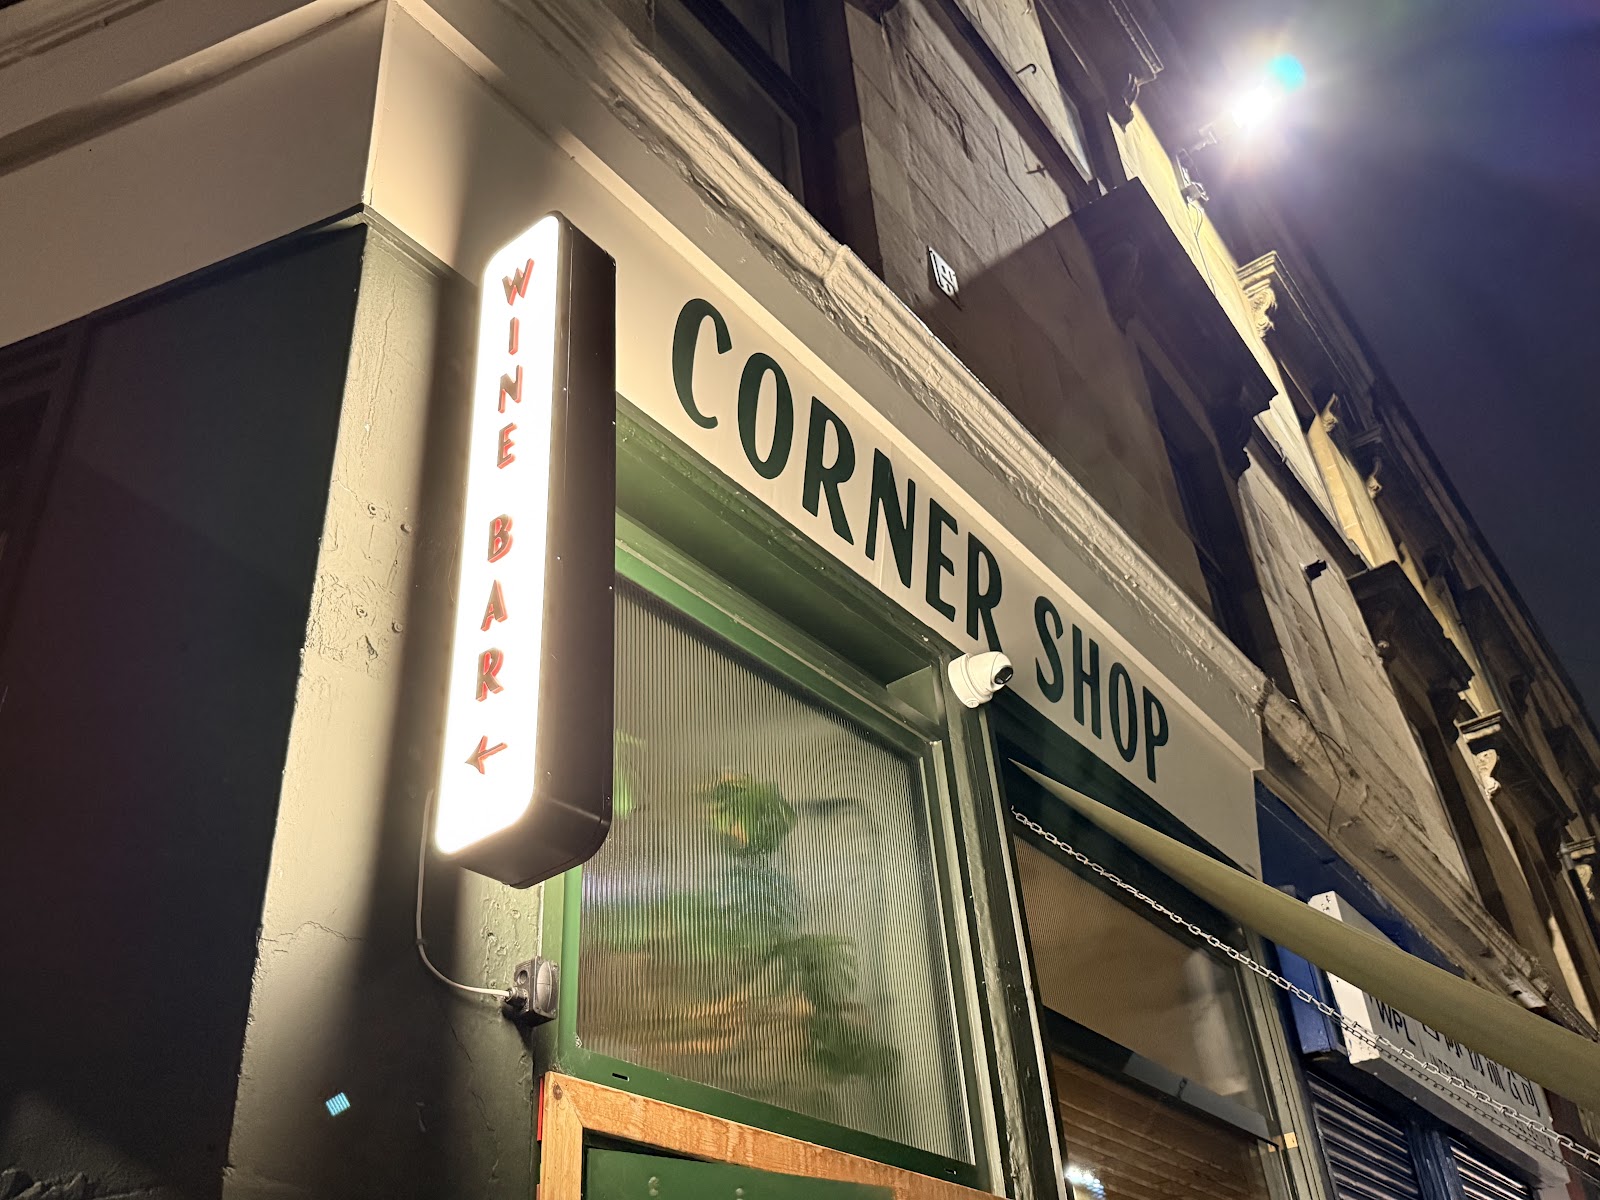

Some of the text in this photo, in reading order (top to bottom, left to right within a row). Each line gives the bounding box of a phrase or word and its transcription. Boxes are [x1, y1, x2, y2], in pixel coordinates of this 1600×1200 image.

[475, 257, 535, 703] WINE BAR
[671, 297, 1169, 784] CORNER SHOP
